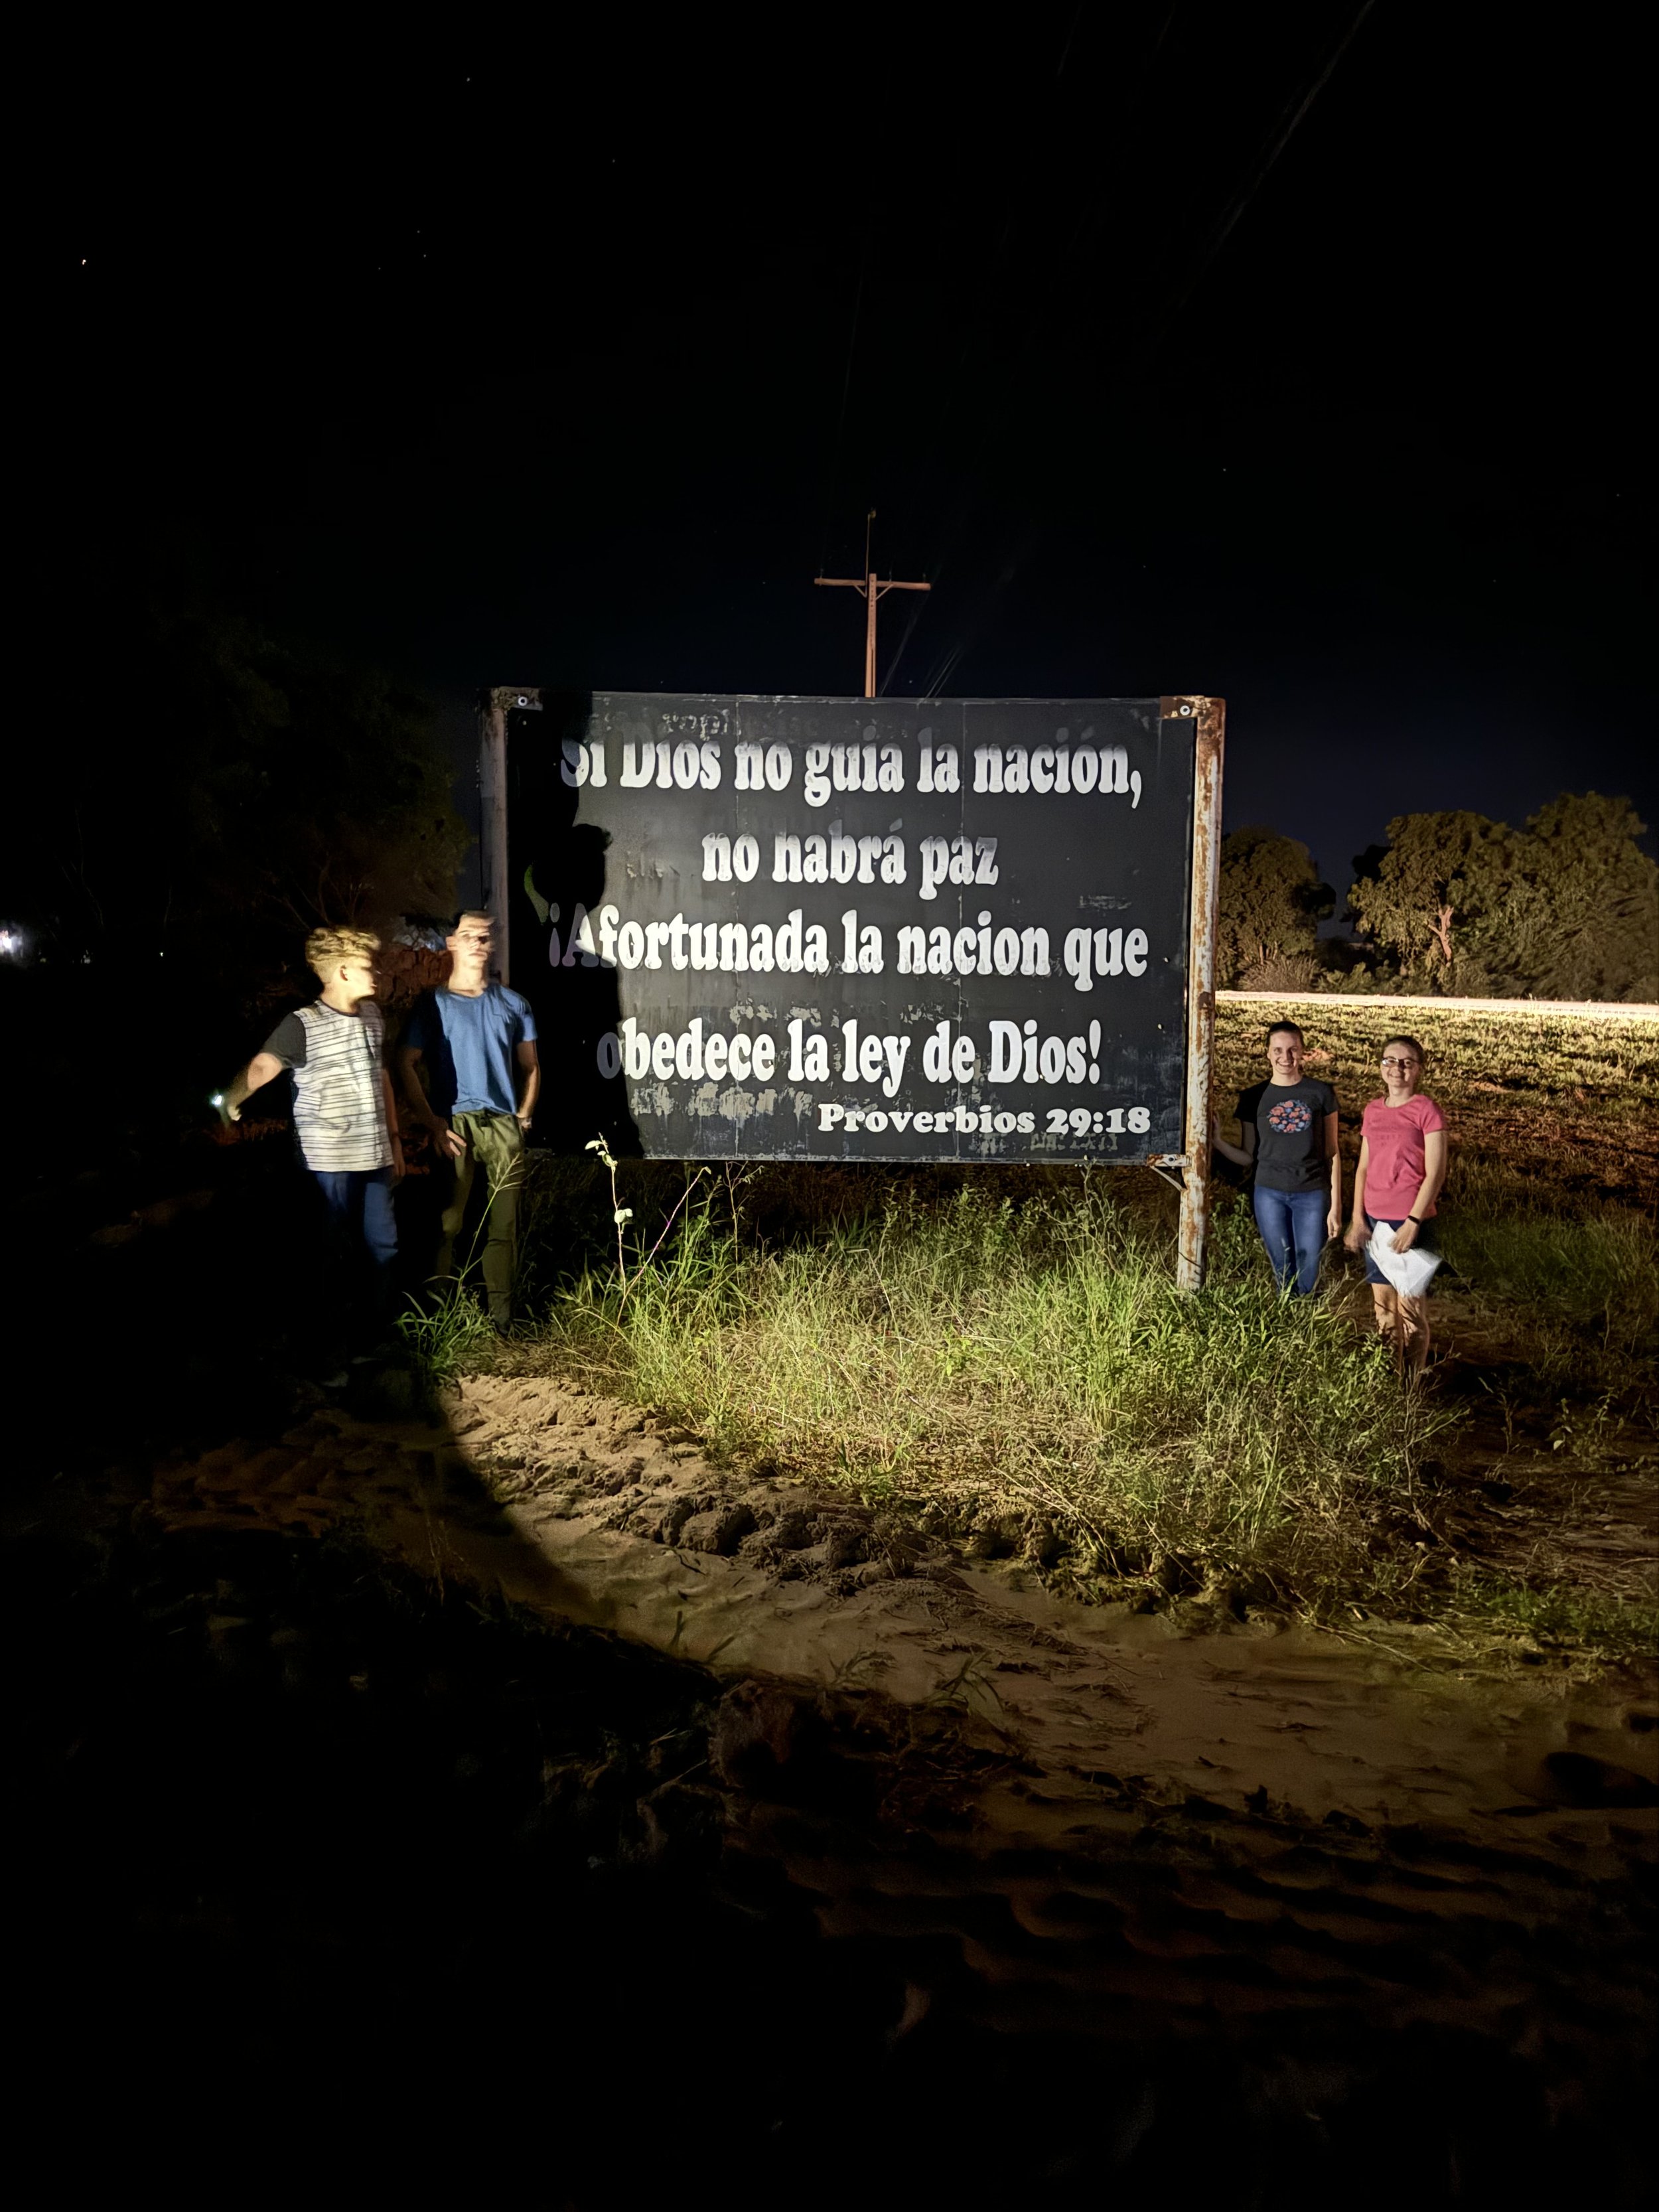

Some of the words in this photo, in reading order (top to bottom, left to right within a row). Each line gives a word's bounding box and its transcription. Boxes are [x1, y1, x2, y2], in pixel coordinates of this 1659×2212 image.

[620, 723, 721, 790] Dios
[734, 740, 793, 791] no
[916, 727, 960, 793] la
[701, 832, 760, 883] no
[919, 836, 999, 900] paz
[841, 909, 885, 974] la
[897, 910, 1051, 976] nacion
[1063, 928, 1149, 992] que
[597, 1016, 776, 1082] obedece
[786, 1018, 830, 1082] la
[841, 1019, 911, 1098] ley
[922, 1019, 976, 1084] de
[987, 1019, 1102, 1085] Dios!
[818, 1102, 1036, 1134] Proverbios
[1046, 1106, 1151, 1138] 29:18
